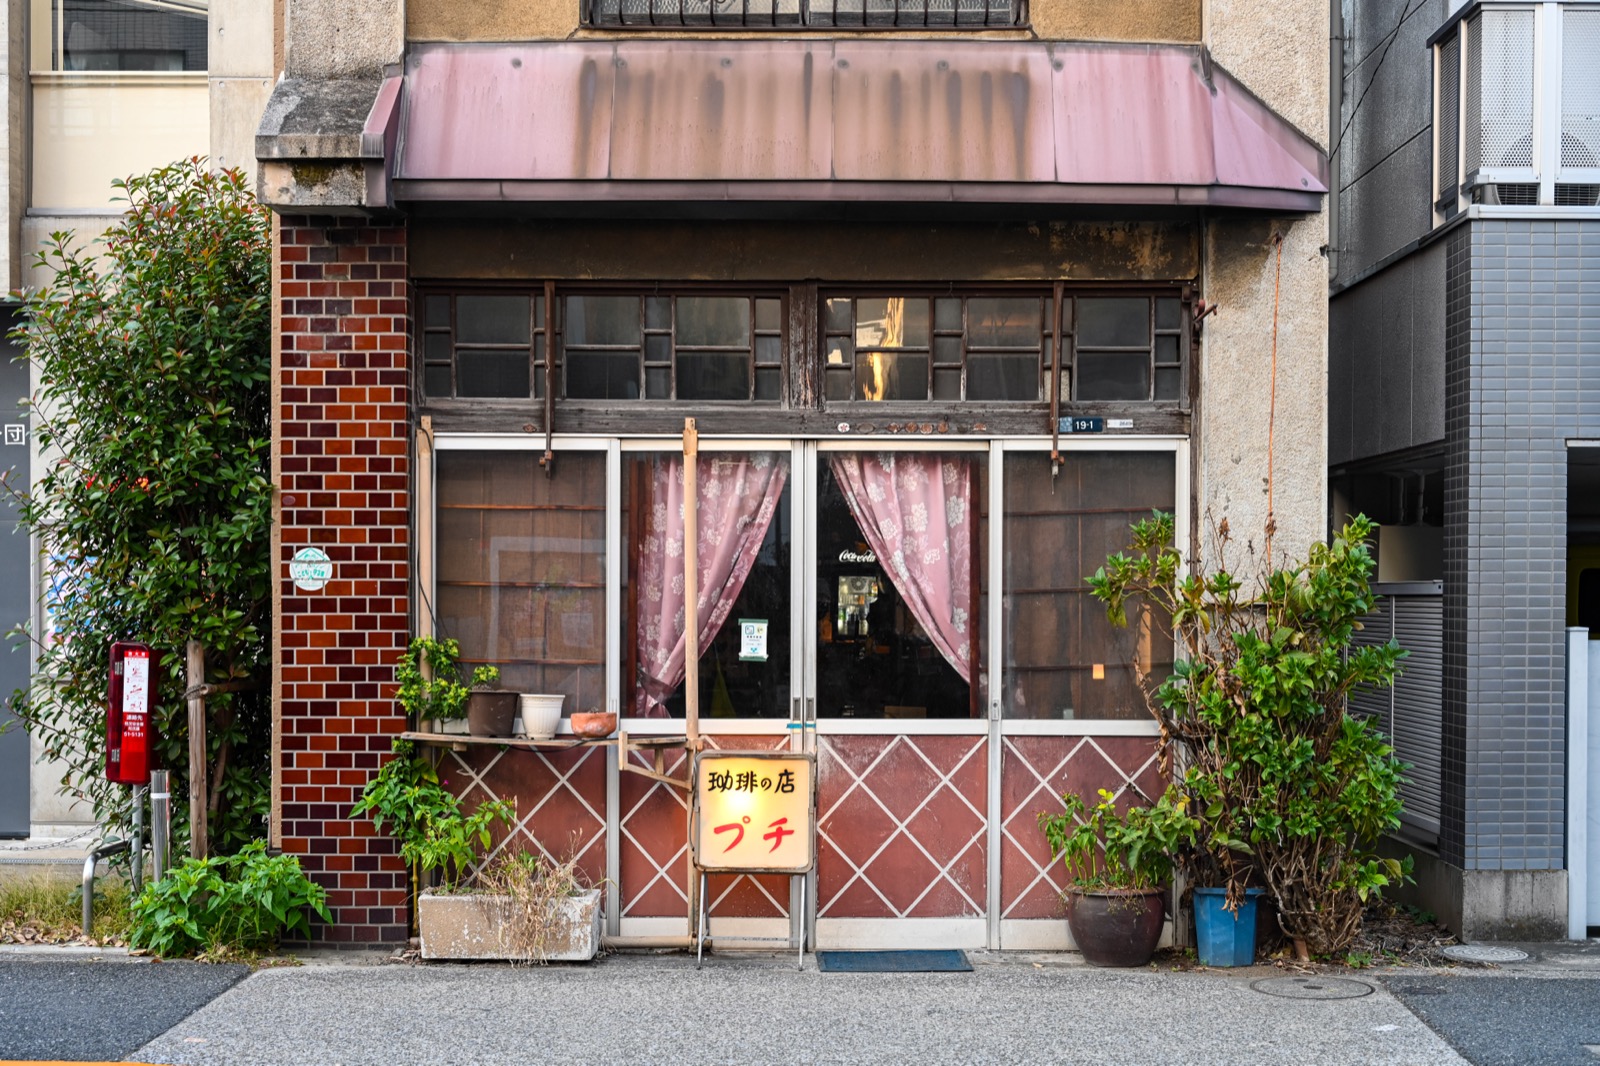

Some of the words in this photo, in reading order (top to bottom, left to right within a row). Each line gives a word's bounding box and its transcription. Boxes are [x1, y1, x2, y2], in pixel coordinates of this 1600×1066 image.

[1075, 420, 1093, 430] 19-1
[708, 769, 795, 794] 珈琲の店
[713, 815, 795, 854] プチ
